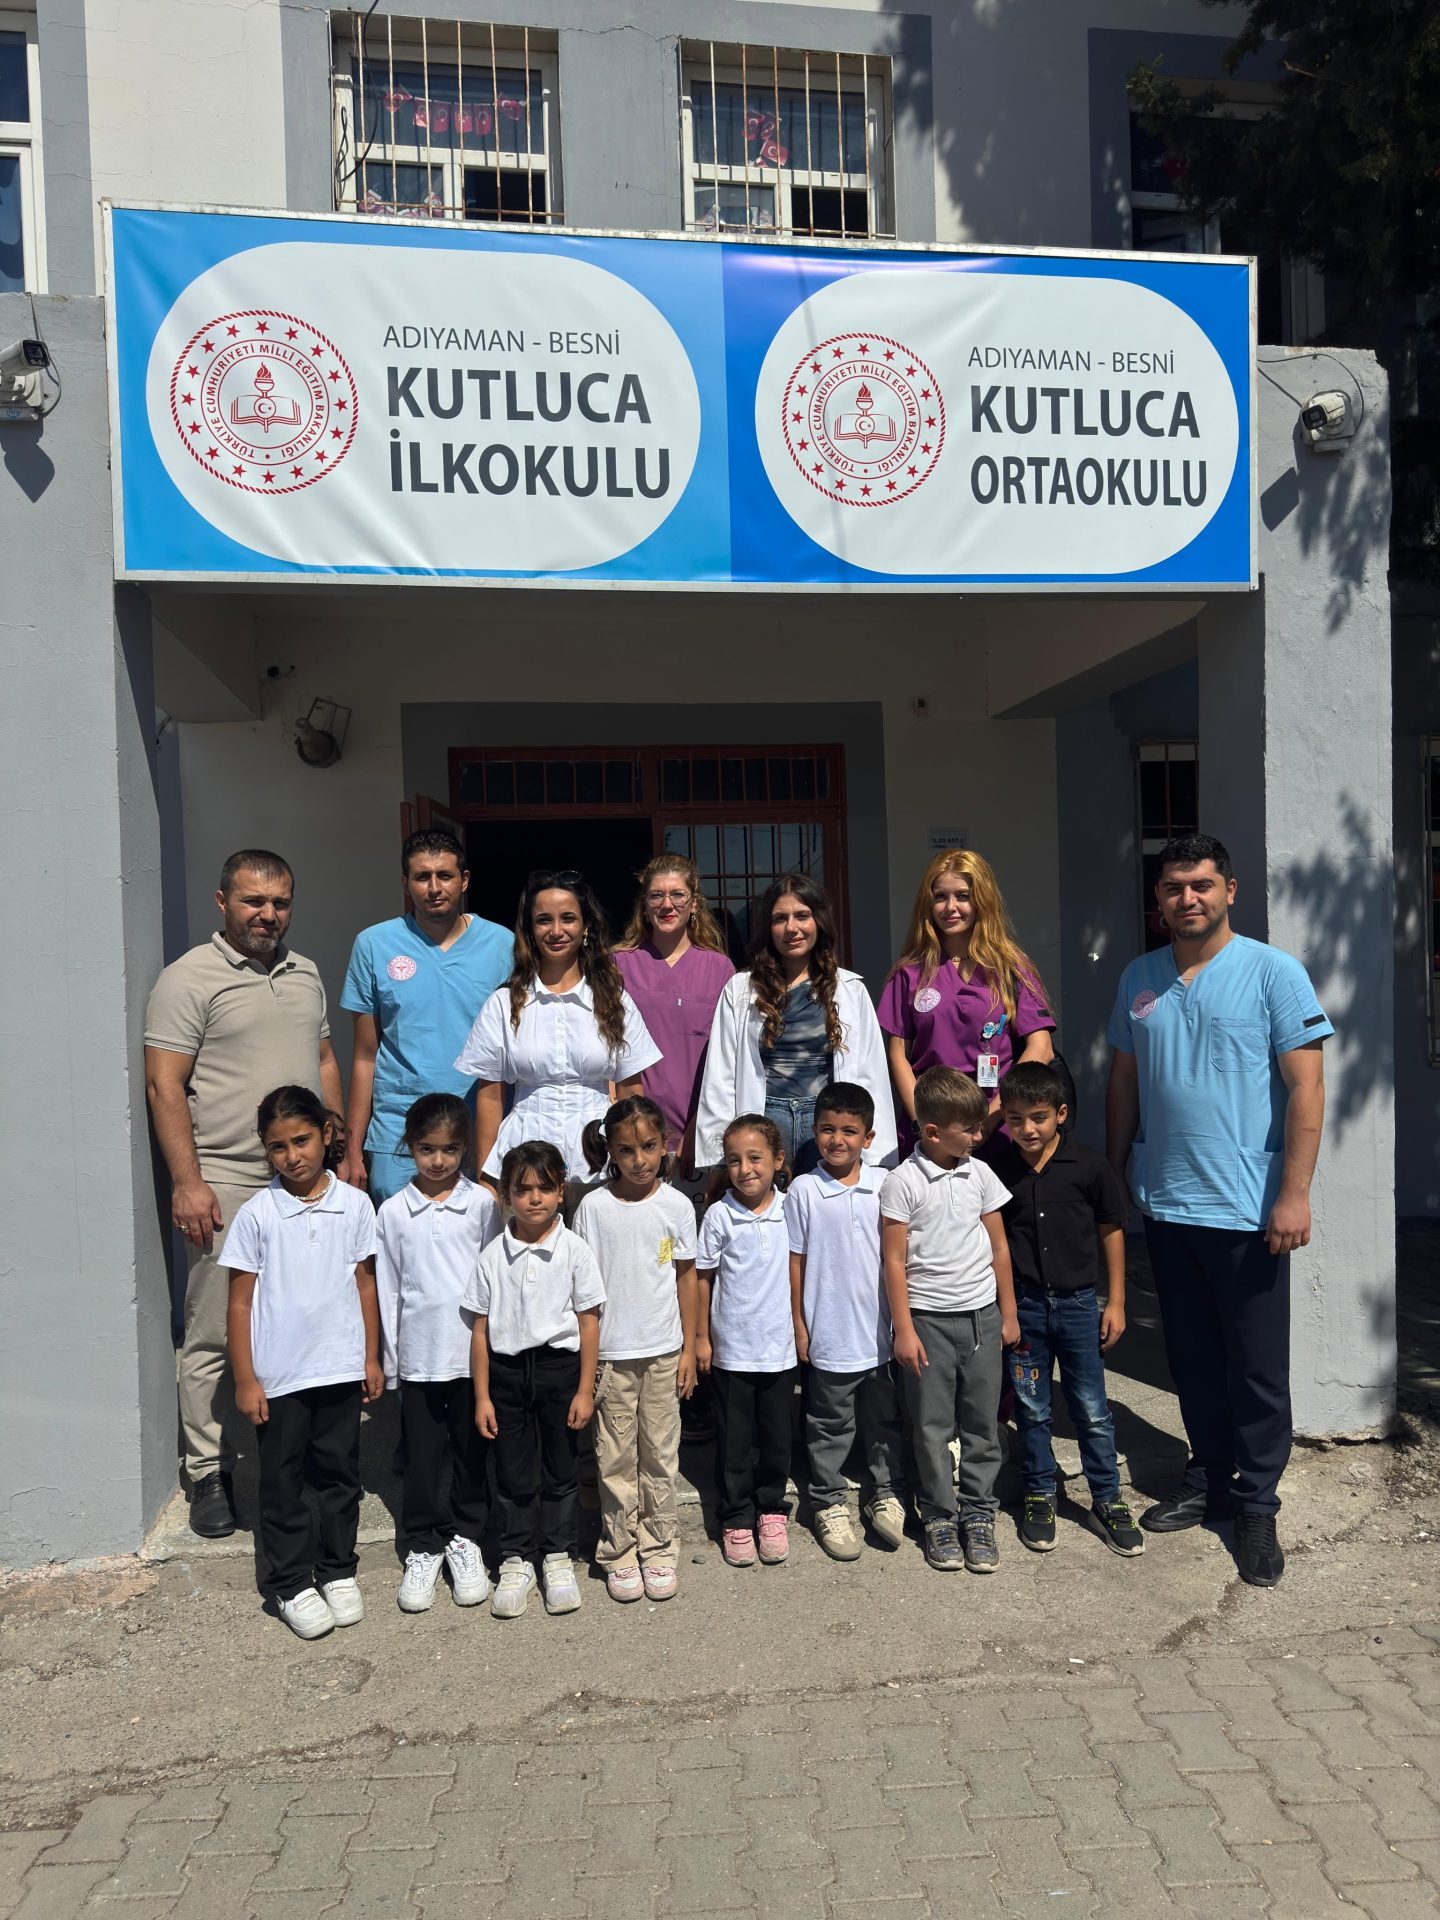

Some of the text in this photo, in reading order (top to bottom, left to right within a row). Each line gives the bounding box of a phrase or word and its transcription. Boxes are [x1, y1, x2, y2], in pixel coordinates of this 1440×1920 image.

[384, 326, 523, 352] ADIYAMAN
[549, 328, 620, 354] BESNİ
[968, 347, 1090, 371] ADIYAMAN
[1112, 347, 1175, 373] BESNİ
[206, 342, 255, 414] CUMHURİYETİ
[295, 358, 324, 401] EĞİTİM
[388, 367, 651, 423] KUTLUCA
[812, 364, 857, 431] CUMHURİYETİ
[891, 379, 917, 417] EĞİTİM
[210, 416, 255, 459] TÜRKİYE
[281, 404, 325, 459] BAKANLIĞI
[971, 386, 1200, 438] KUTLUCA
[390, 429, 669, 498] İLKOKULU
[816, 433, 855, 473] TÜRKİYE
[877, 420, 917, 473] BAKANLIĞI
[971, 456, 1206, 506] ORTAOKULU
